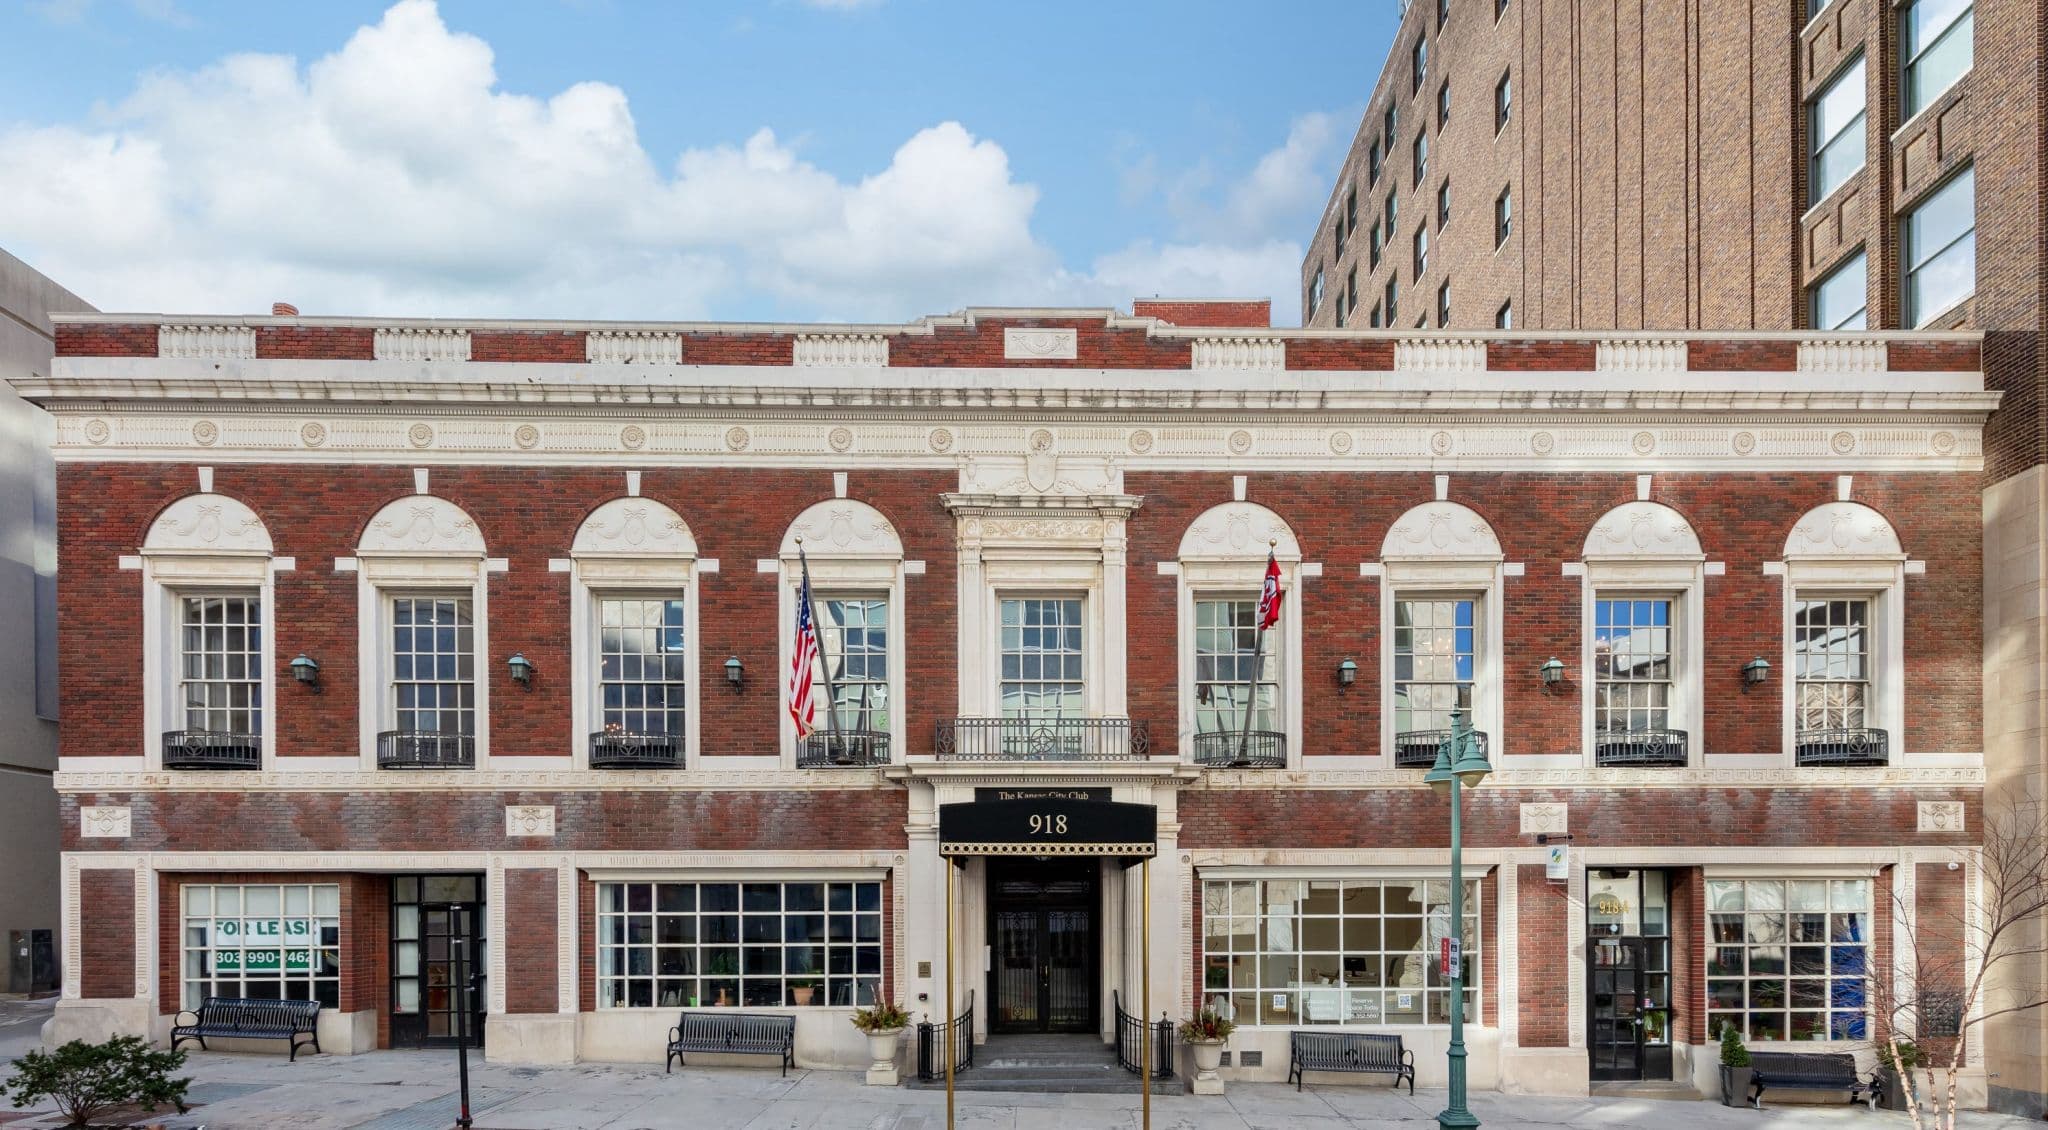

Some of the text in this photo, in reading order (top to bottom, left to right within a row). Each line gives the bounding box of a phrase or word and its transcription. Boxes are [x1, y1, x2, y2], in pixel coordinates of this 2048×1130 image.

[999, 791, 1015, 800] The
[1068, 791, 1089, 800] Club
[1029, 814, 1068, 834] 918
[216, 951, 313, 963] 303990-462
